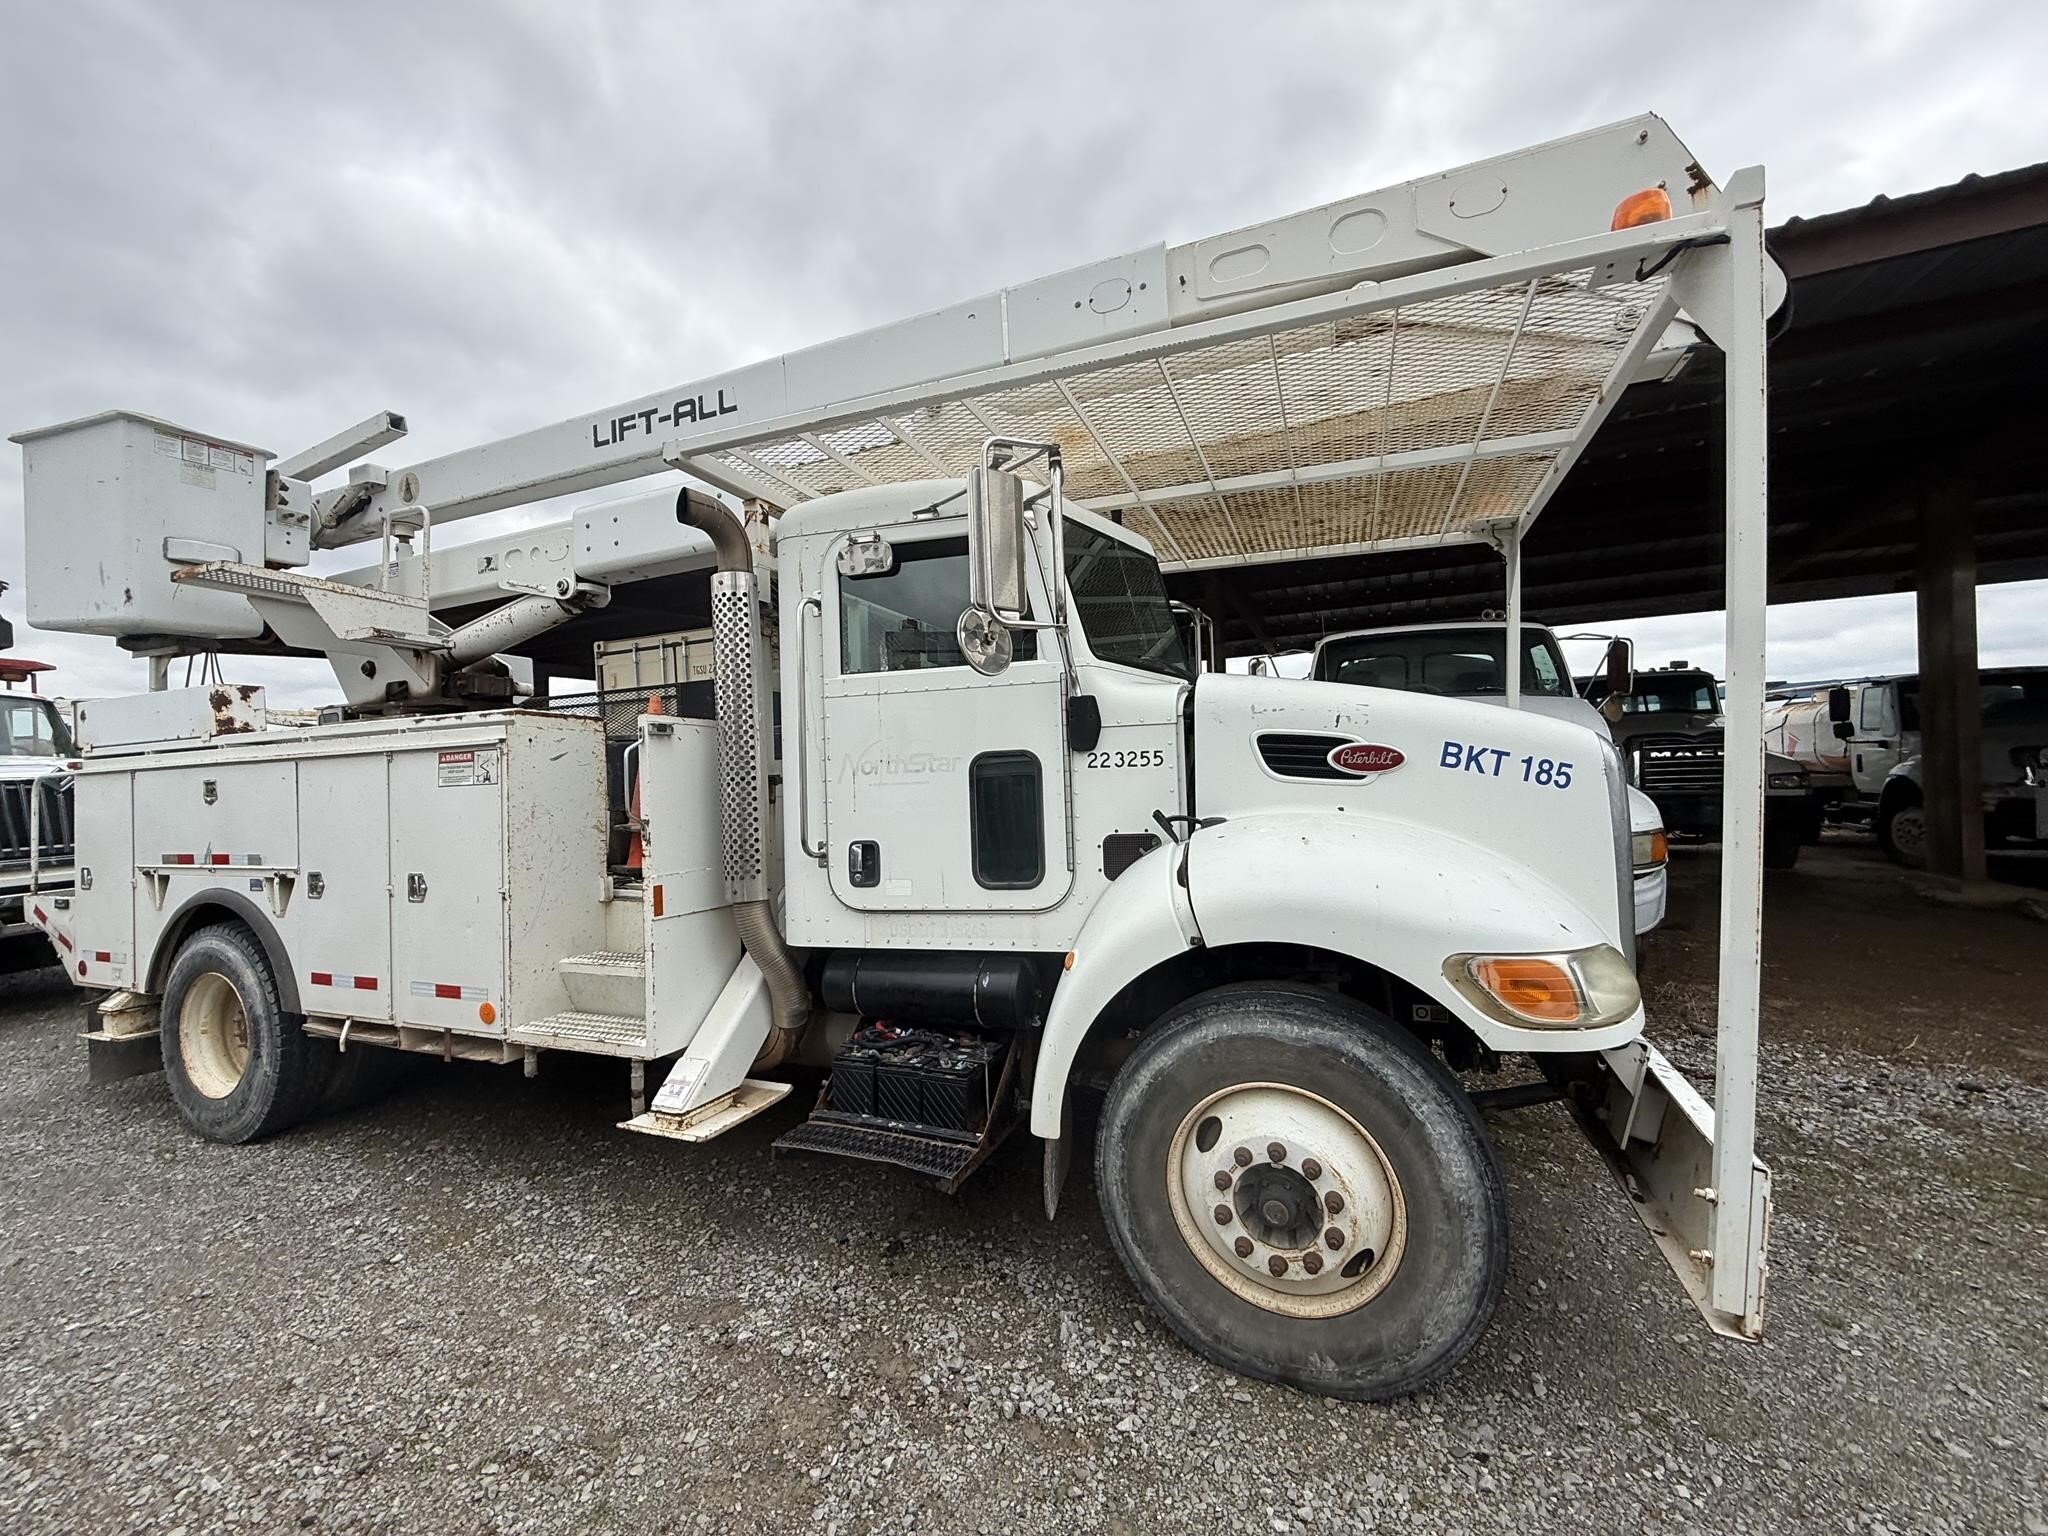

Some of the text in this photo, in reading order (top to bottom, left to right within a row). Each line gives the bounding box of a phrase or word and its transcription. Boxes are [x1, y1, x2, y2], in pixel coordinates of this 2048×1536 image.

[592, 389, 738, 448] LIFT-ALL
[1087, 750, 1164, 769] 223255
[1340, 749, 1398, 765] Peterbilt
[1439, 741, 1574, 789] BKT 185
